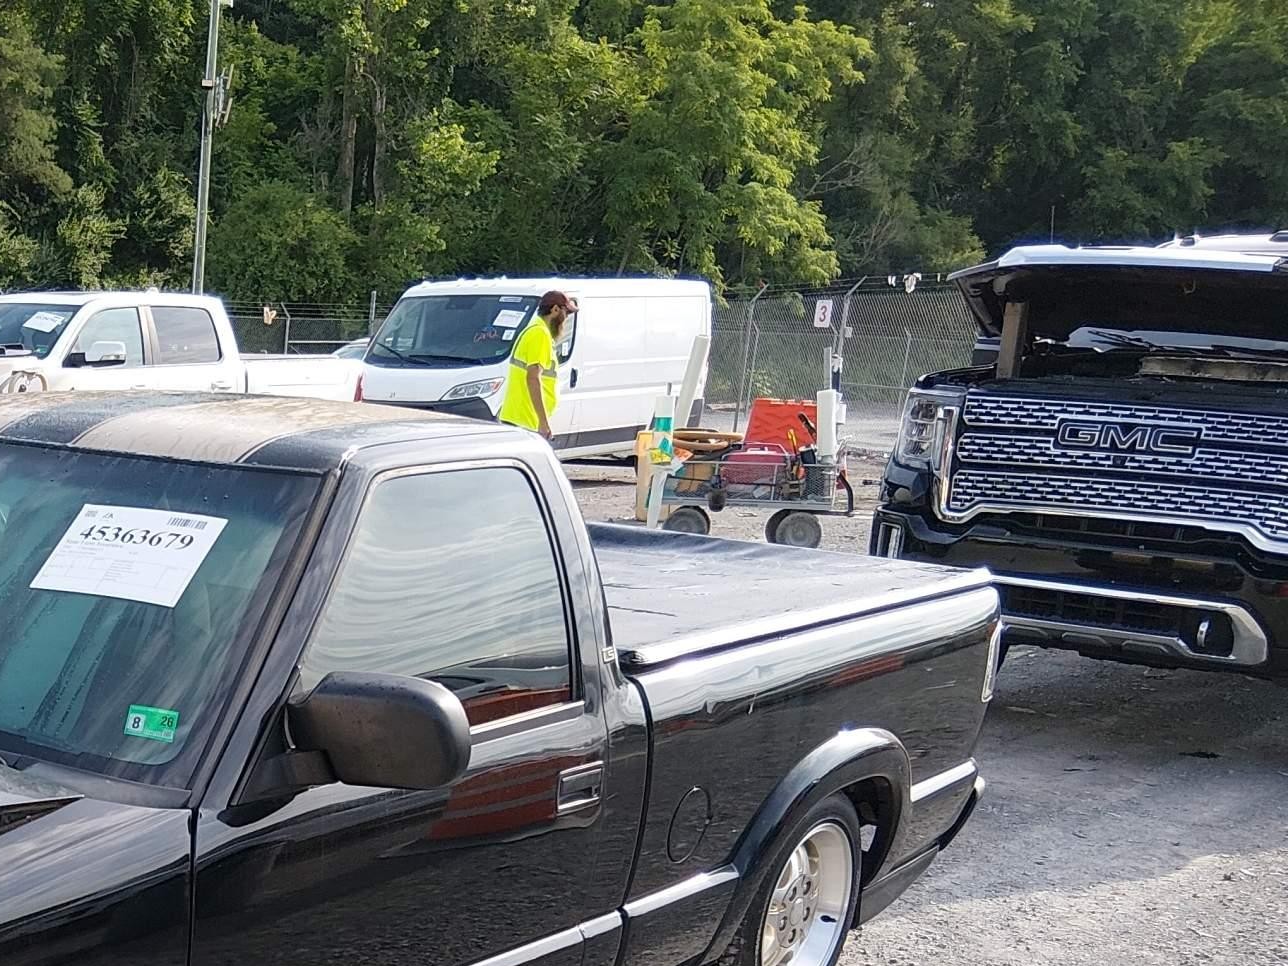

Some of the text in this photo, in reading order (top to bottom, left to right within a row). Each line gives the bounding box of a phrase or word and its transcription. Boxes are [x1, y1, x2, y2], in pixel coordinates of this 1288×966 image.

[819, 305, 827, 322] 3
[1058, 422, 1197, 453] GMC
[80, 524, 194, 550] 45363679
[132, 715, 174, 729] 8 26
